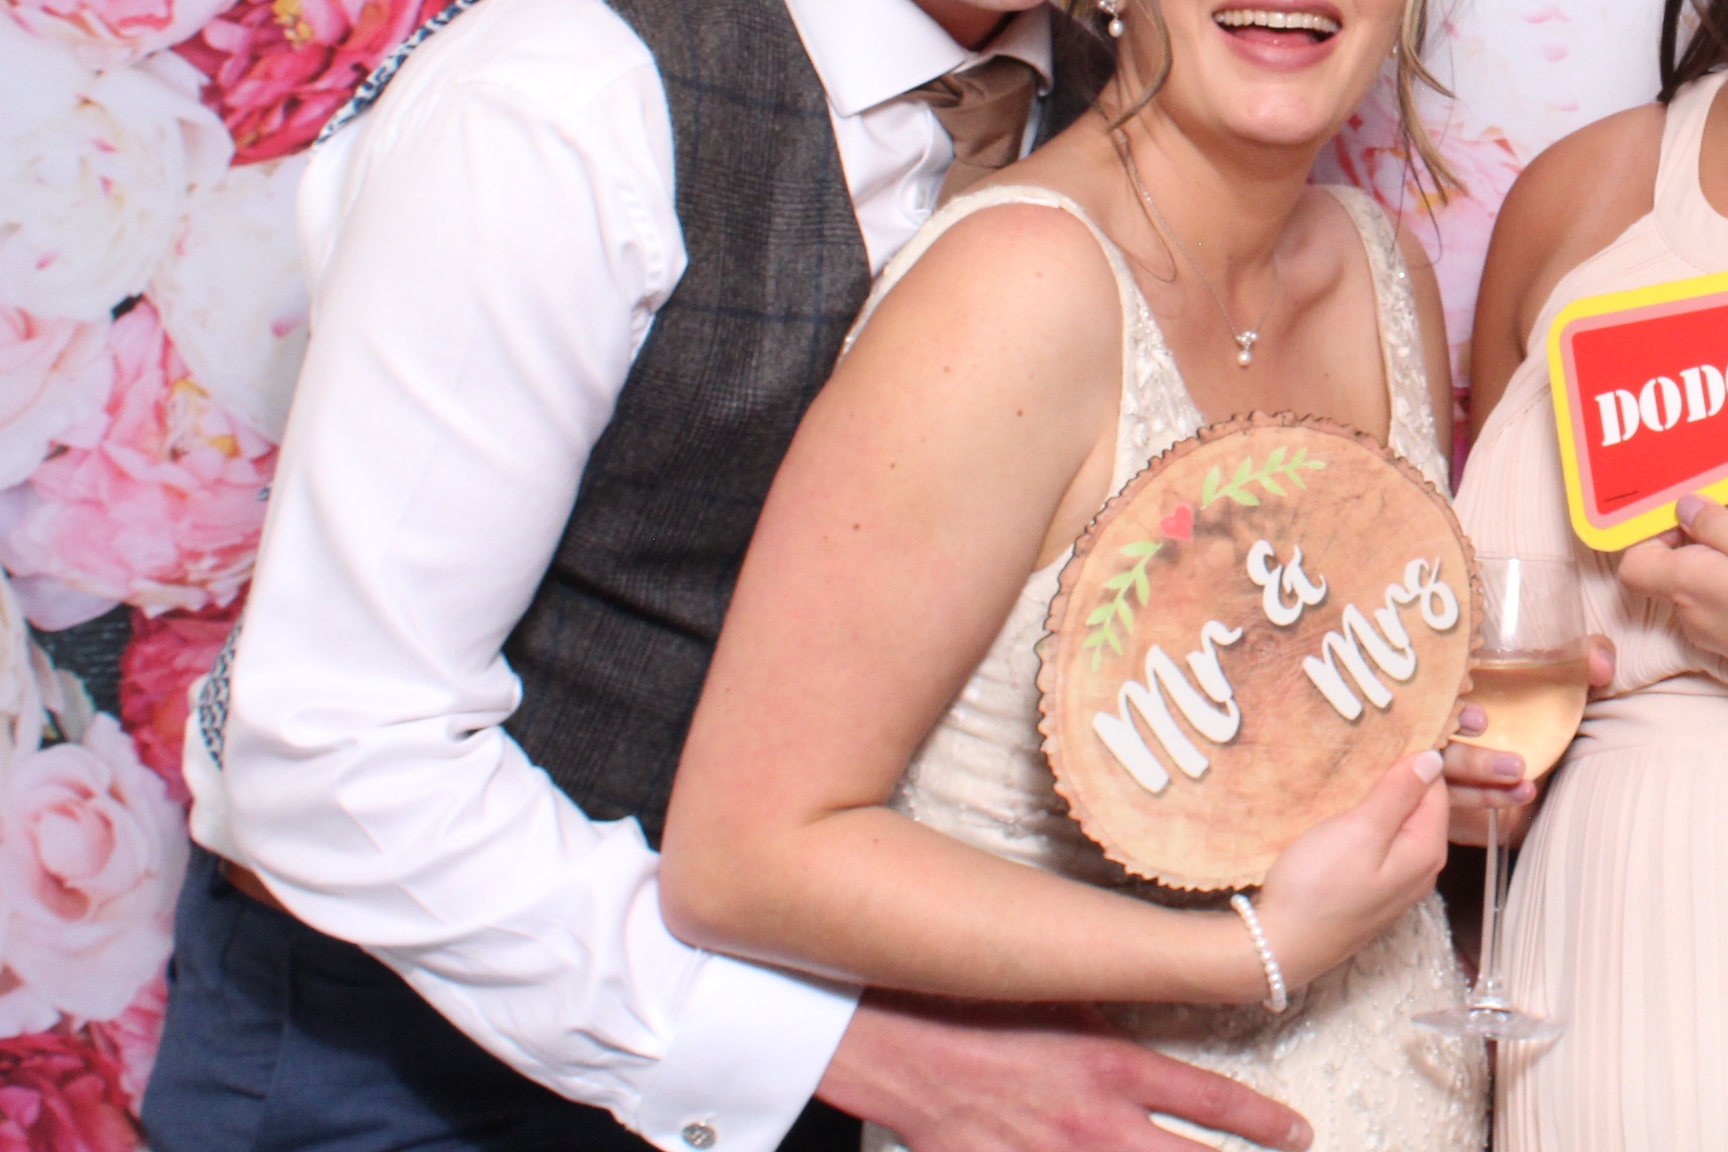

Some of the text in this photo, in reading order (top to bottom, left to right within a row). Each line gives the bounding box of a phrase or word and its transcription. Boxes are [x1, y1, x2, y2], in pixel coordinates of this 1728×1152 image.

[1092, 539, 1327, 794] Mr &
[1302, 556, 1460, 721] Mrs
